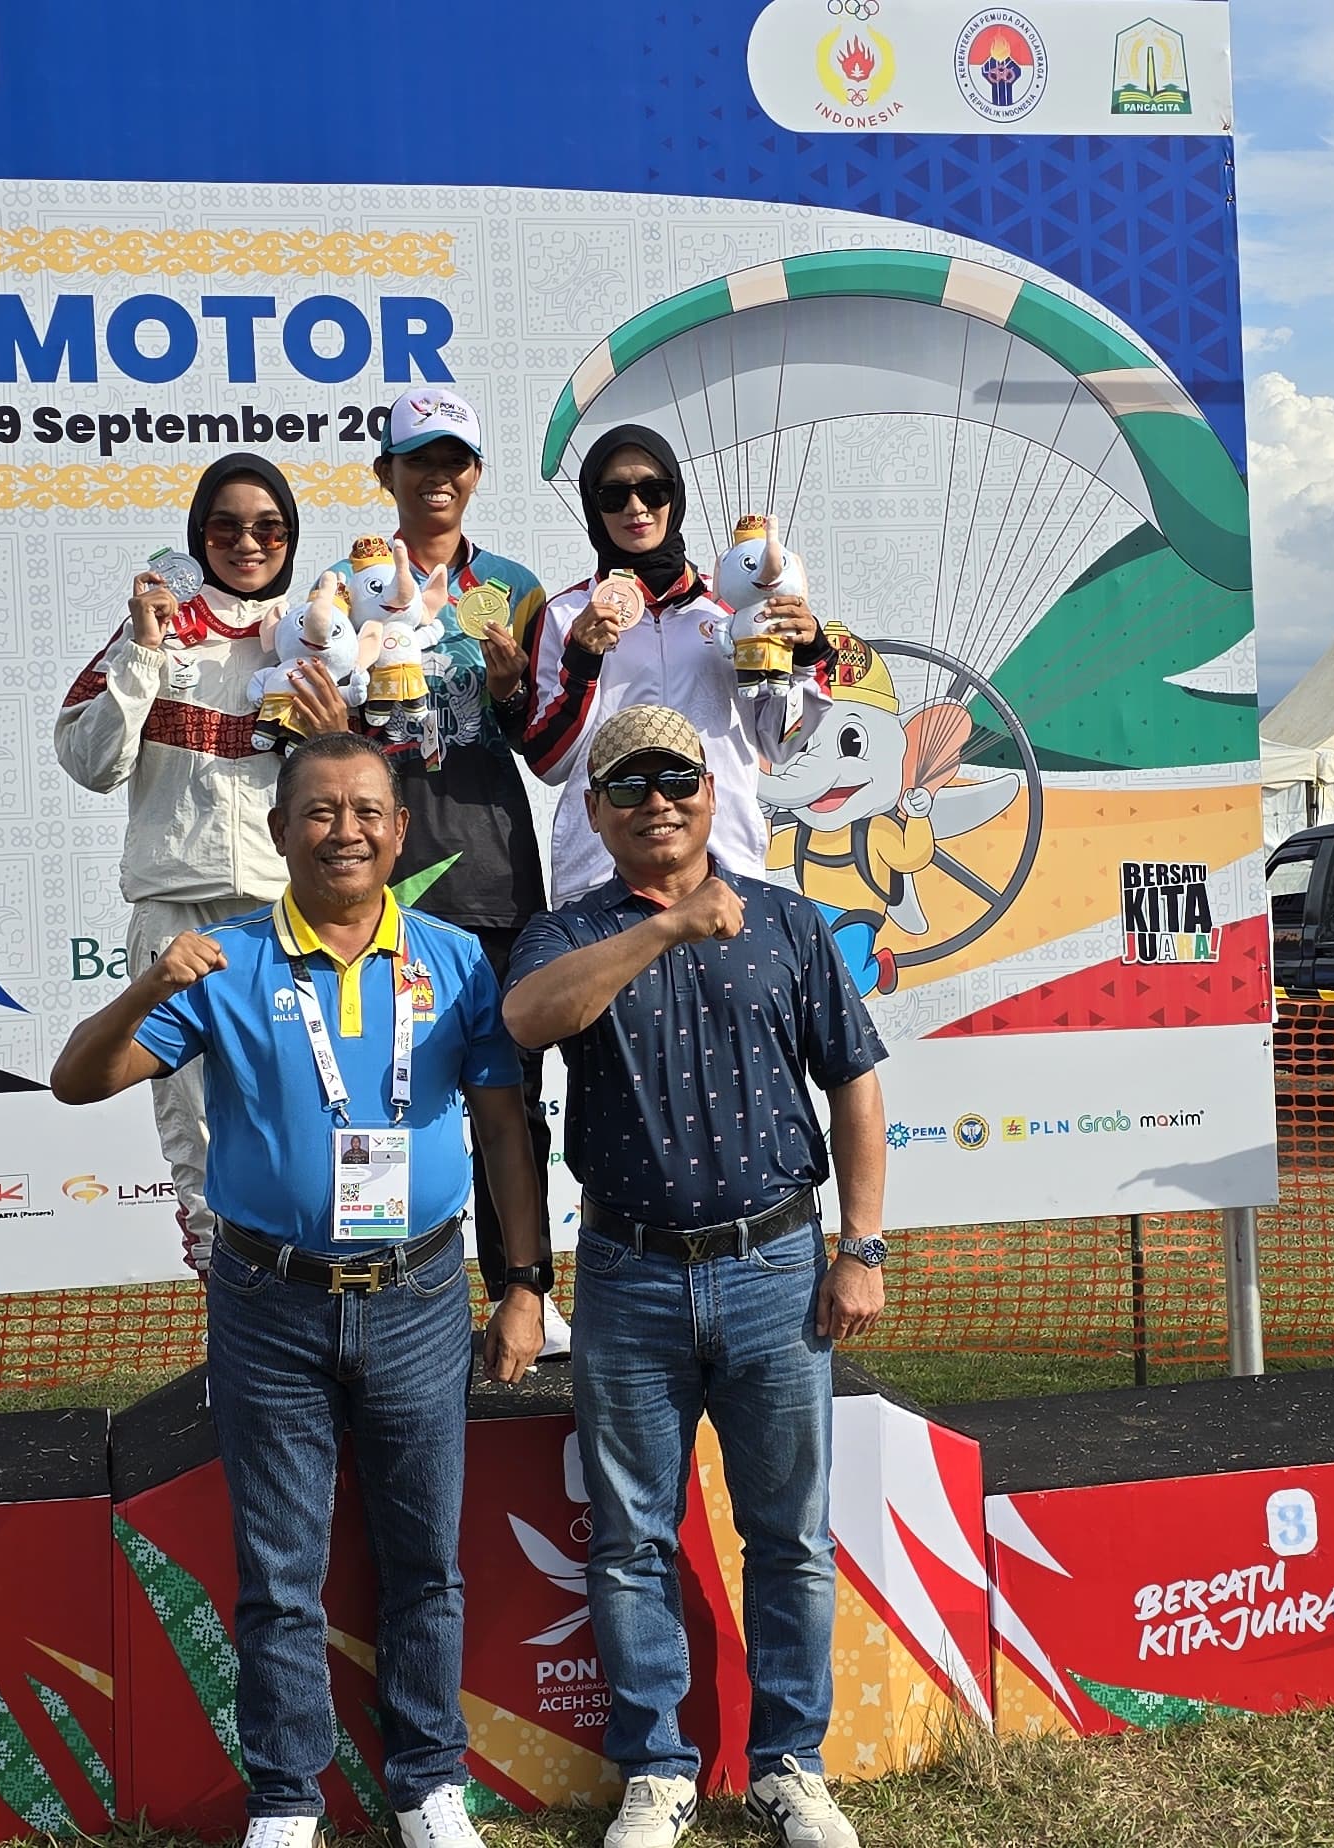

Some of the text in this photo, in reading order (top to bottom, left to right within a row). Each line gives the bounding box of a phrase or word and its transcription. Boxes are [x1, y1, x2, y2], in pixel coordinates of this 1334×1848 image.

[959, 13, 1044, 79] KEMENTERIAN PEMUDA DAN OLAHRAGA
[815, 101, 904, 128] INDONESIA
[968, 92, 1037, 117] REPUBLIK INDONESIA
[1123, 103, 1181, 112] PANCACITA
[33, 404, 329, 457] September
[1123, 863, 1207, 888] BERSATU
[1124, 883, 1213, 934] KITA
[1123, 928, 1222, 962] JUARA!
[272, 1013, 300, 1022] MILLS
[1029, 1119, 1070, 1135] PLN
[1077, 1110, 1132, 1134] Grab
[1139, 1110, 1201, 1128] maxim
[912, 1127, 947, 1138] PEMA
[118, 1182, 176, 1199] LMR
[1276, 1504, 1307, 1546] 3
[1134, 1561, 1287, 1621] BERSATU
[1138, 1613, 1222, 1661] KITA
[536, 1657, 597, 1685] PON
[537, 1686, 564, 1695] PEKAN
[538, 1693, 613, 1713] ACEH-SU
